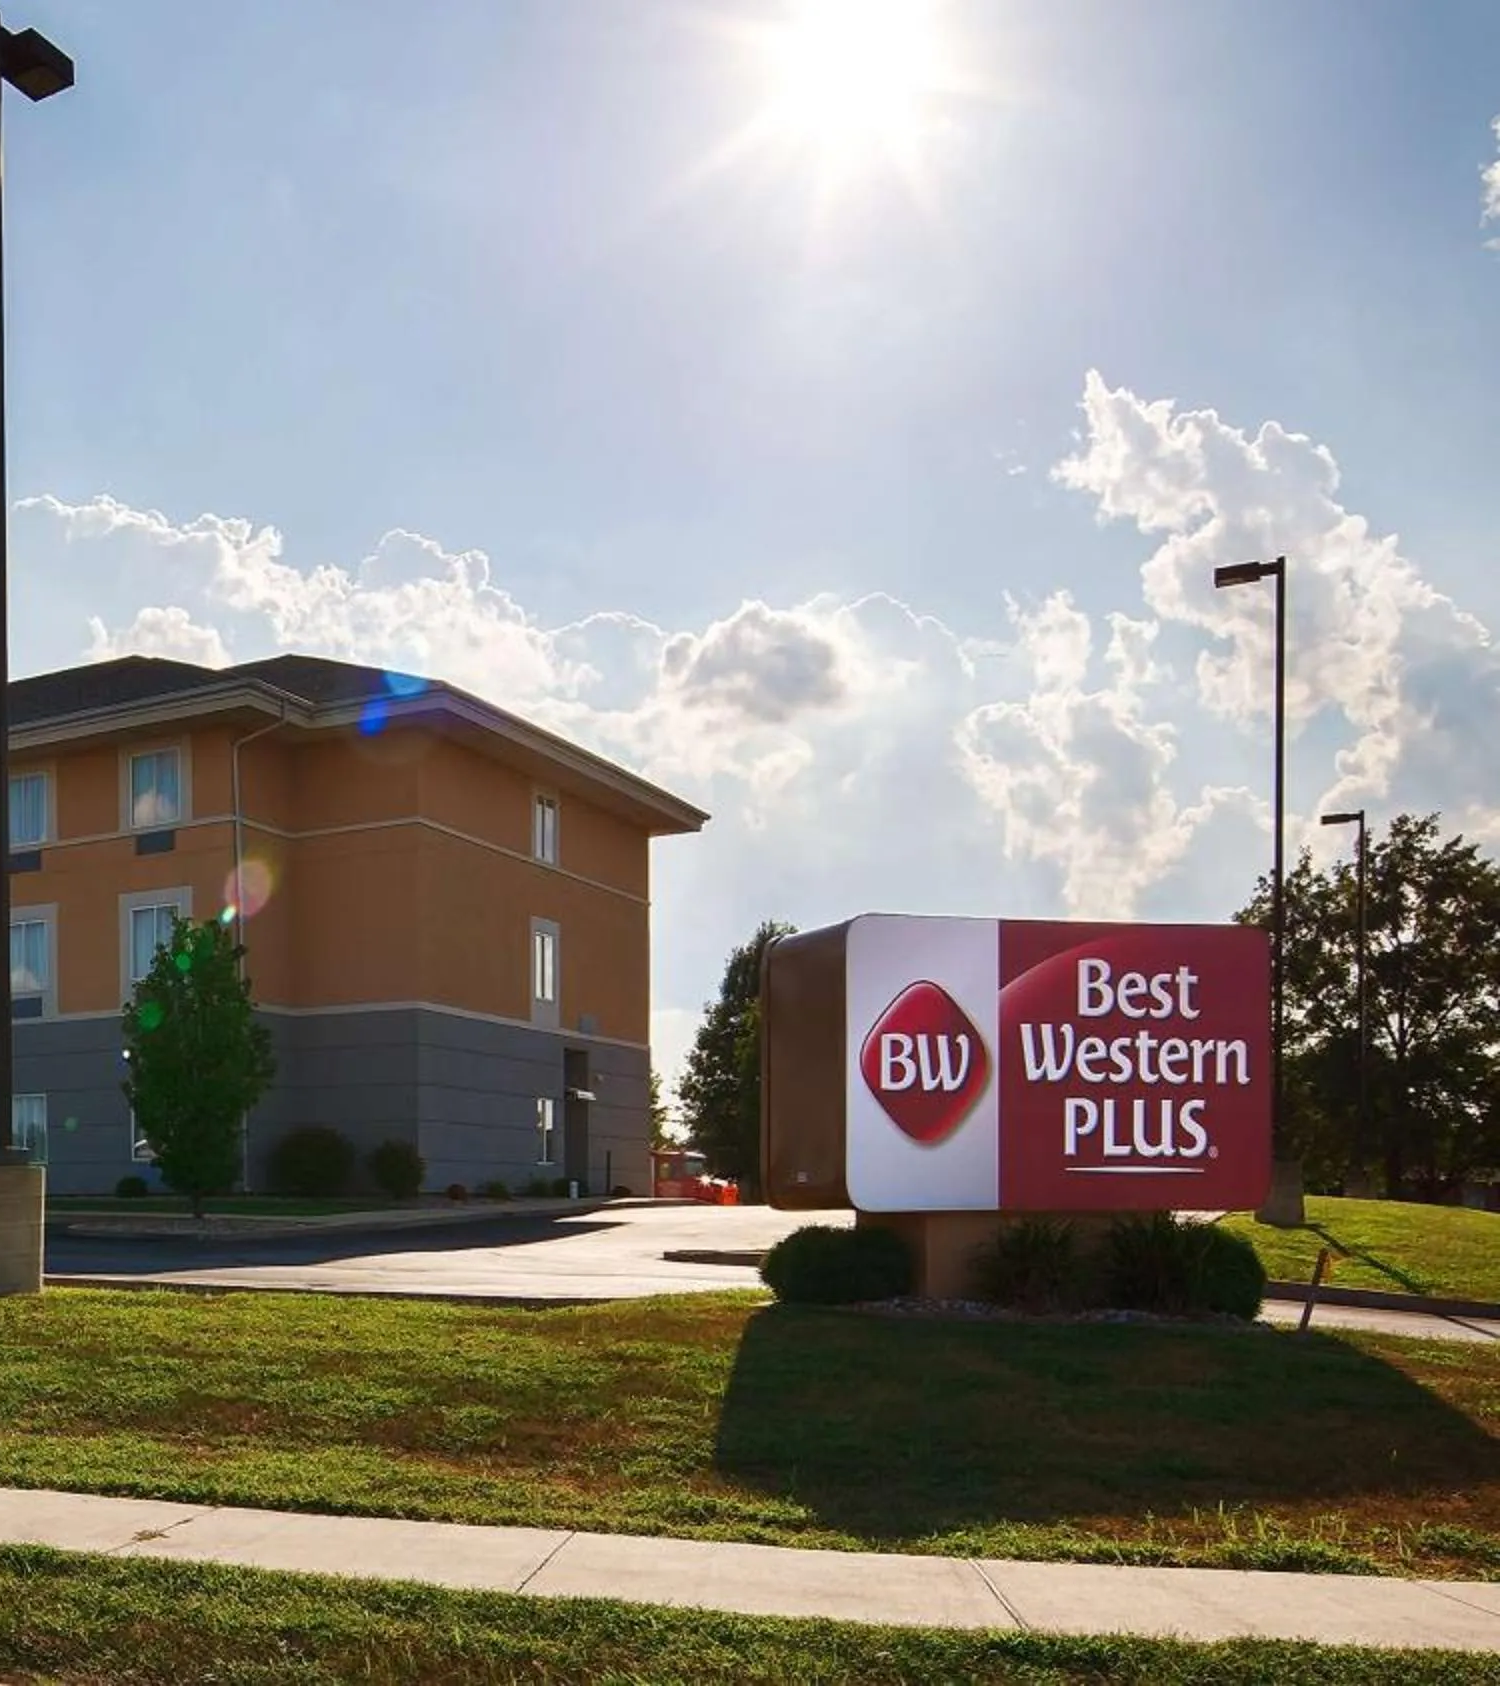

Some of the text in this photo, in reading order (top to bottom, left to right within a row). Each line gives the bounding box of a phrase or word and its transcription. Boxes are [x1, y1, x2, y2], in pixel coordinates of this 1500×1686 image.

[1076, 958, 1201, 1020] Best
[879, 1033, 971, 1092] BW
[1019, 1022, 1251, 1085] Western
[1063, 1097, 1208, 1158] PLUS
